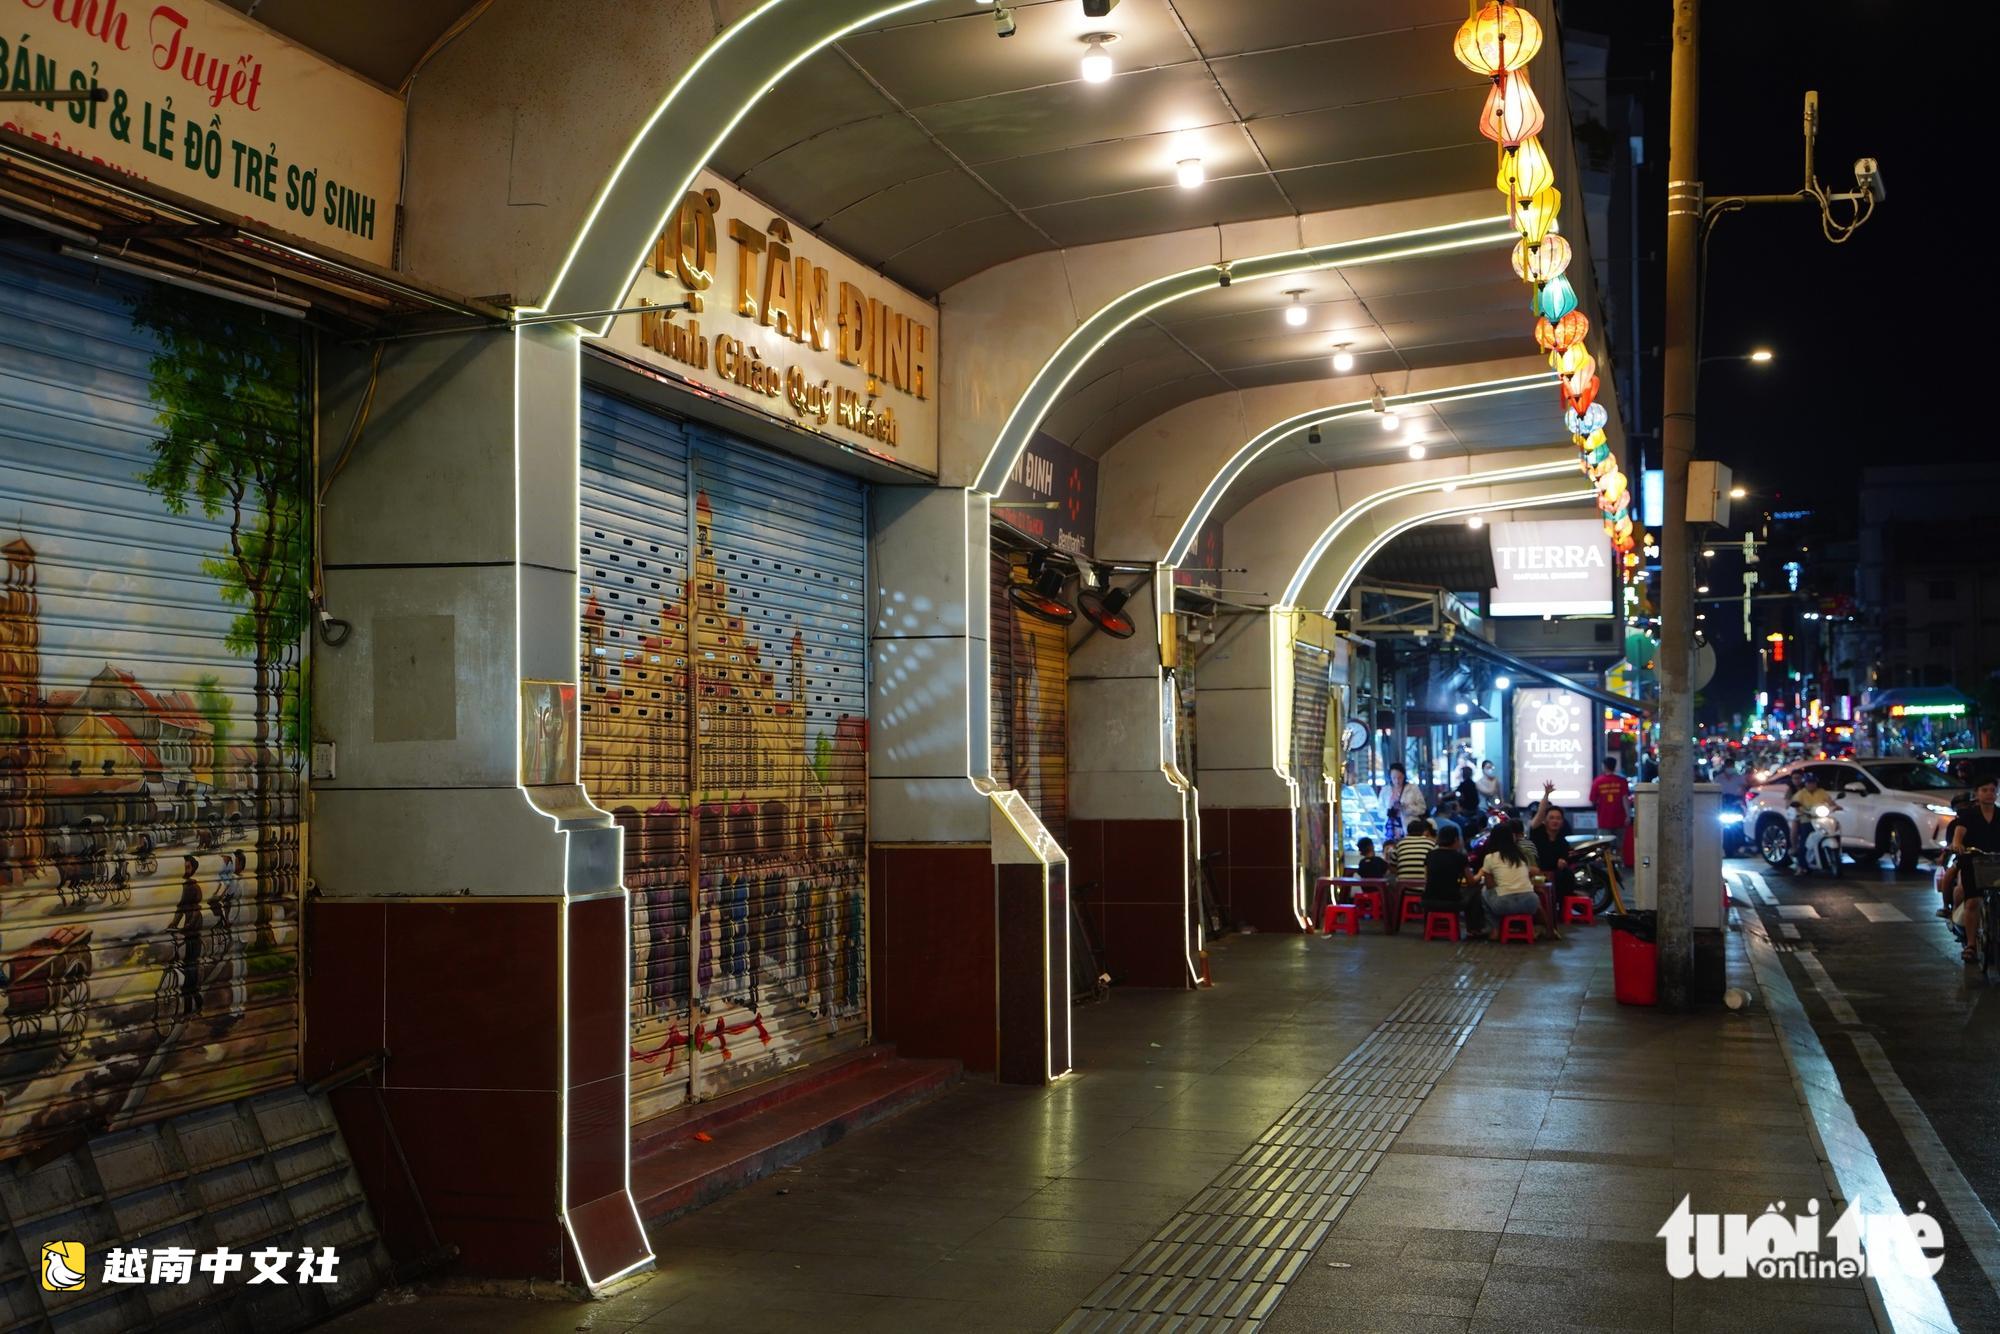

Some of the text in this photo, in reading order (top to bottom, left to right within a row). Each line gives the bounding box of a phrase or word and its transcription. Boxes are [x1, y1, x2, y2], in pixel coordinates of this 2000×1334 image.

[149, 5, 264, 112] Tuyết
[110, 89, 131, 143] &
[143, 96, 176, 161] LẺ
[184, 113, 222, 180] ĐỒ
[231, 142, 279, 202] TRẺ
[285, 164, 318, 217] SƠ
[323, 180, 376, 240] SINH
[729, 217, 829, 352] TÂN
[838, 281, 930, 401] ĐỊNH
[641, 297, 898, 447] Kính Chào Quý Khách
[1025, 452, 1053, 500] ĐỊNH
[1497, 545, 1604, 570] TIERRA
[1524, 734, 1582, 753] TIERRA
